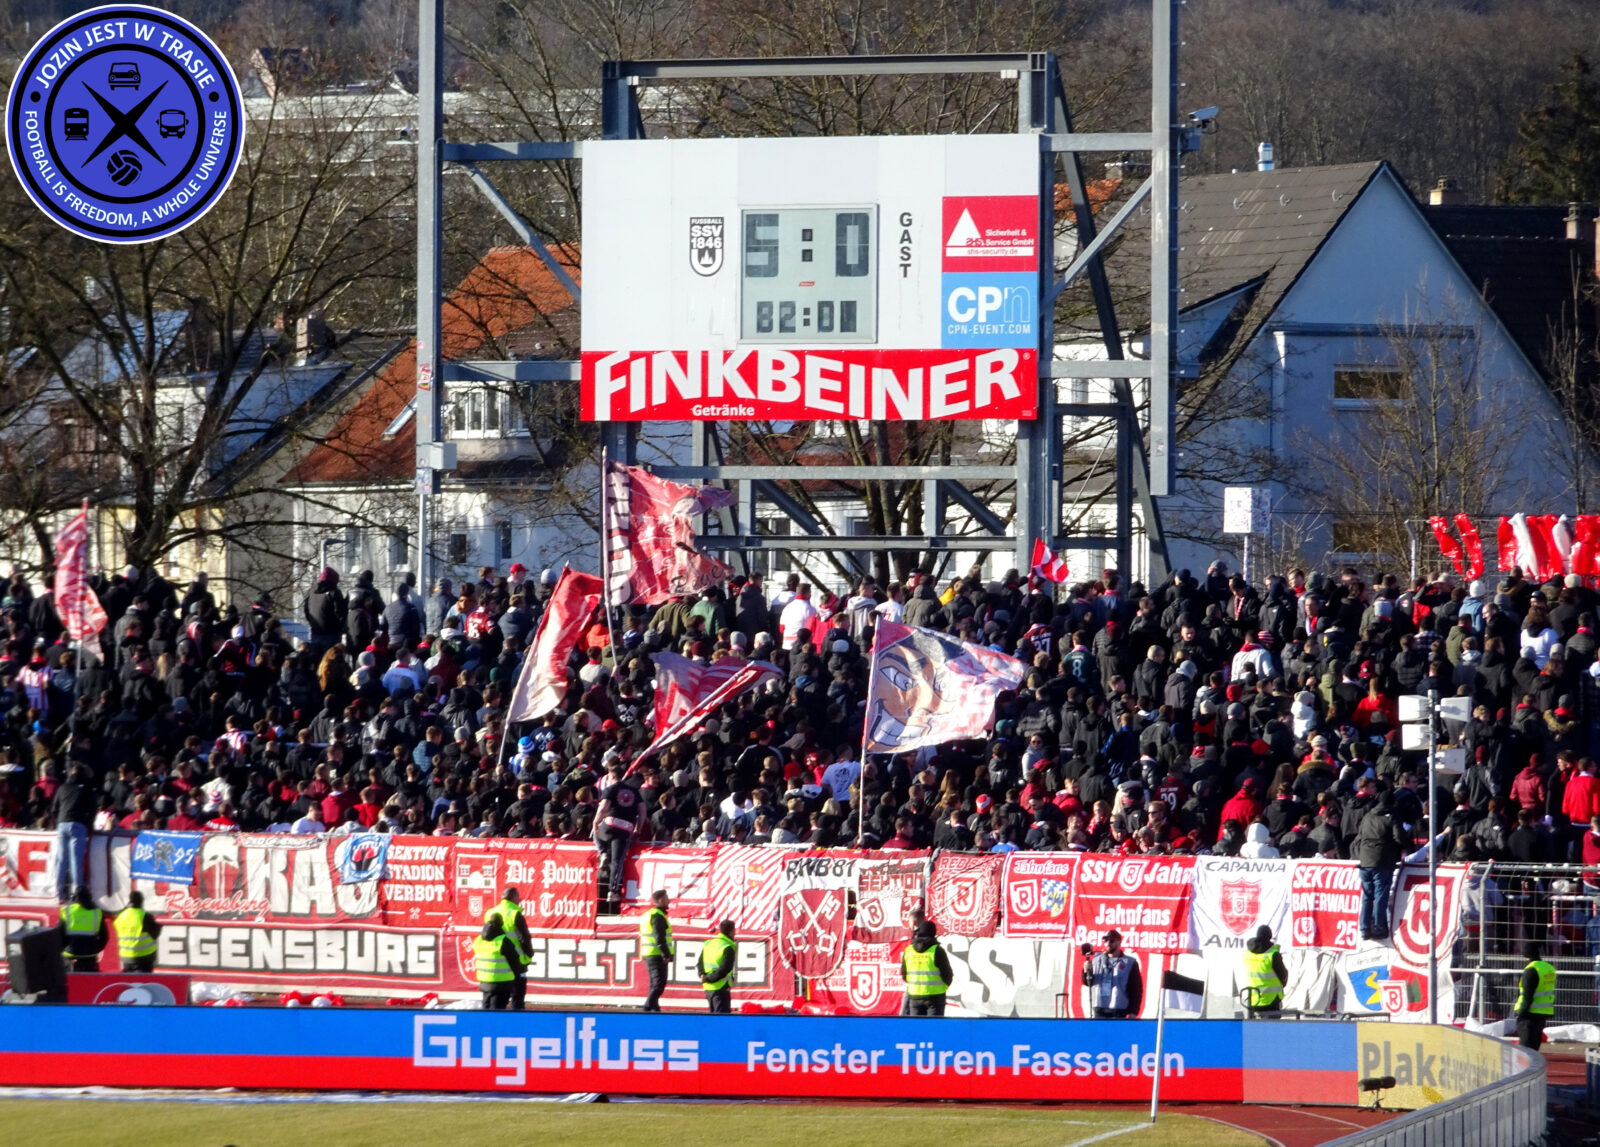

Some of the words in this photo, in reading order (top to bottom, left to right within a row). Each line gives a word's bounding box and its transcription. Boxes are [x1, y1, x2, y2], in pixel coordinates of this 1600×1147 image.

[691, 225, 723, 237] SSV
[985, 229, 1020, 237] Sicherheit
[1012, 238, 1034, 246] GmbH
[691, 237, 722, 249] 1846
[899, 212, 913, 279] GAST
[947, 324, 1031, 334] CPN-EVENT.COM
[594, 348, 1021, 420] FINKBEINER
[692, 404, 755, 417] Getränke
[386, 845, 449, 860] SEKTION
[388, 864, 445, 880] STADION
[505, 859, 535, 884] Die
[541, 859, 594, 888] Power
[1013, 860, 1070, 876] Jahnfans
[1080, 859, 1120, 883] SSV
[1144, 862, 1194, 884] Jahn
[1205, 861, 1287, 873] CAPANNA
[1293, 865, 1361, 891] SEKTION
[165, 889, 272, 915] Regensburg
[383, 884, 446, 902] VERBOT
[1291, 892, 1359, 913] BAYERWALD
[539, 892, 594, 918] Tower
[1094, 903, 1171, 926] Jahnfans
[1075, 925, 1190, 949] Berzhausen
[1334, 920, 1359, 946] 25
[157, 926, 439, 976] EGENSBURG
[412, 1013, 699, 1086] Gugelfuss
[746, 1040, 884, 1074] Fenster
[896, 1040, 997, 1077] Türen
[1011, 1042, 1186, 1078] Fassaden
